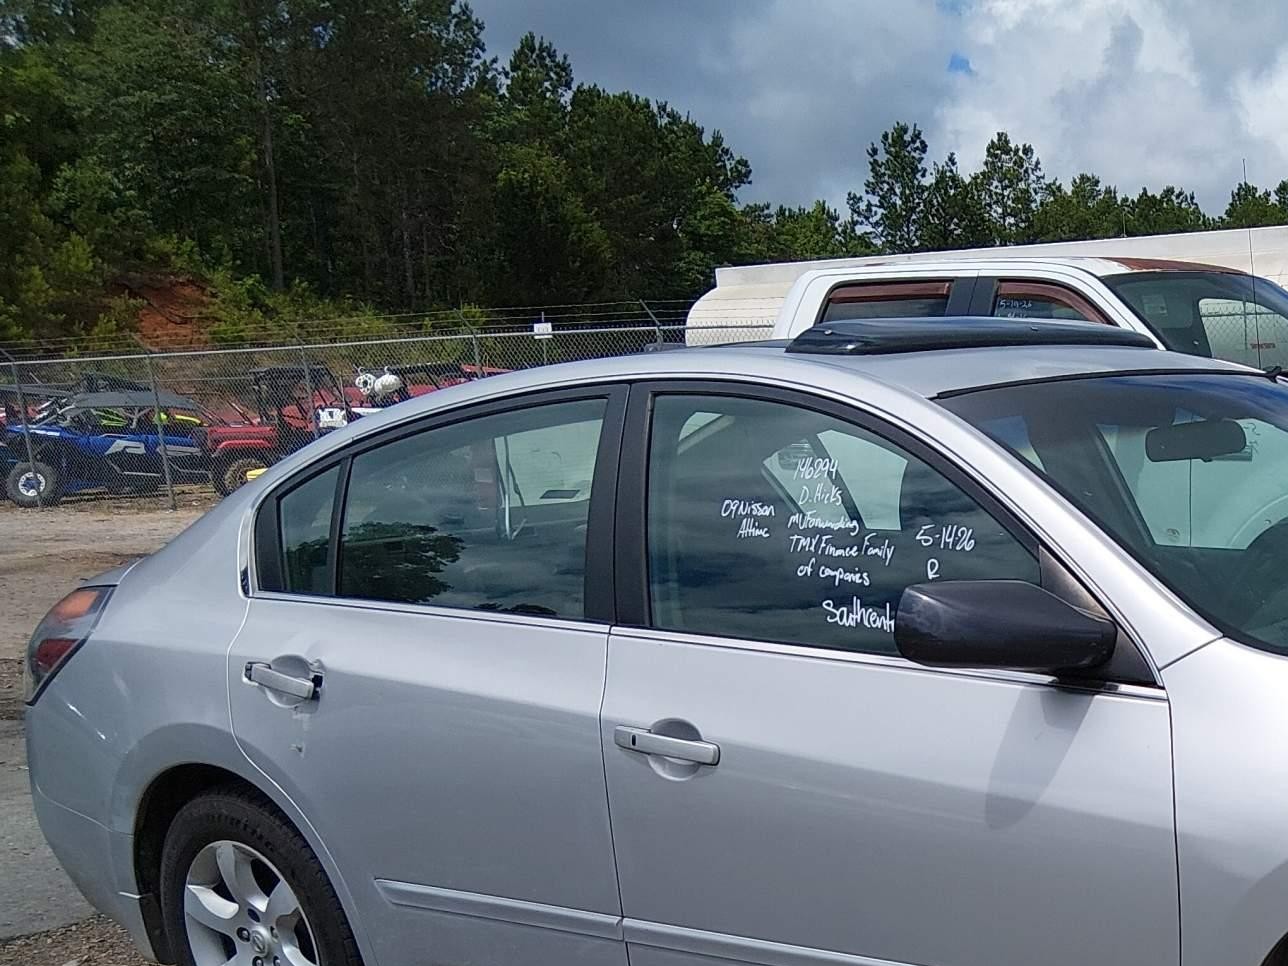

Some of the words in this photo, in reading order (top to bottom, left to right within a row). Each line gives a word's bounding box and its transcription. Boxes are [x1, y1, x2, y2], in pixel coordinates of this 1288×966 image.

[793, 458, 838, 480] 146294
[797, 557, 816, 577] of
[927, 558, 941, 580] R
